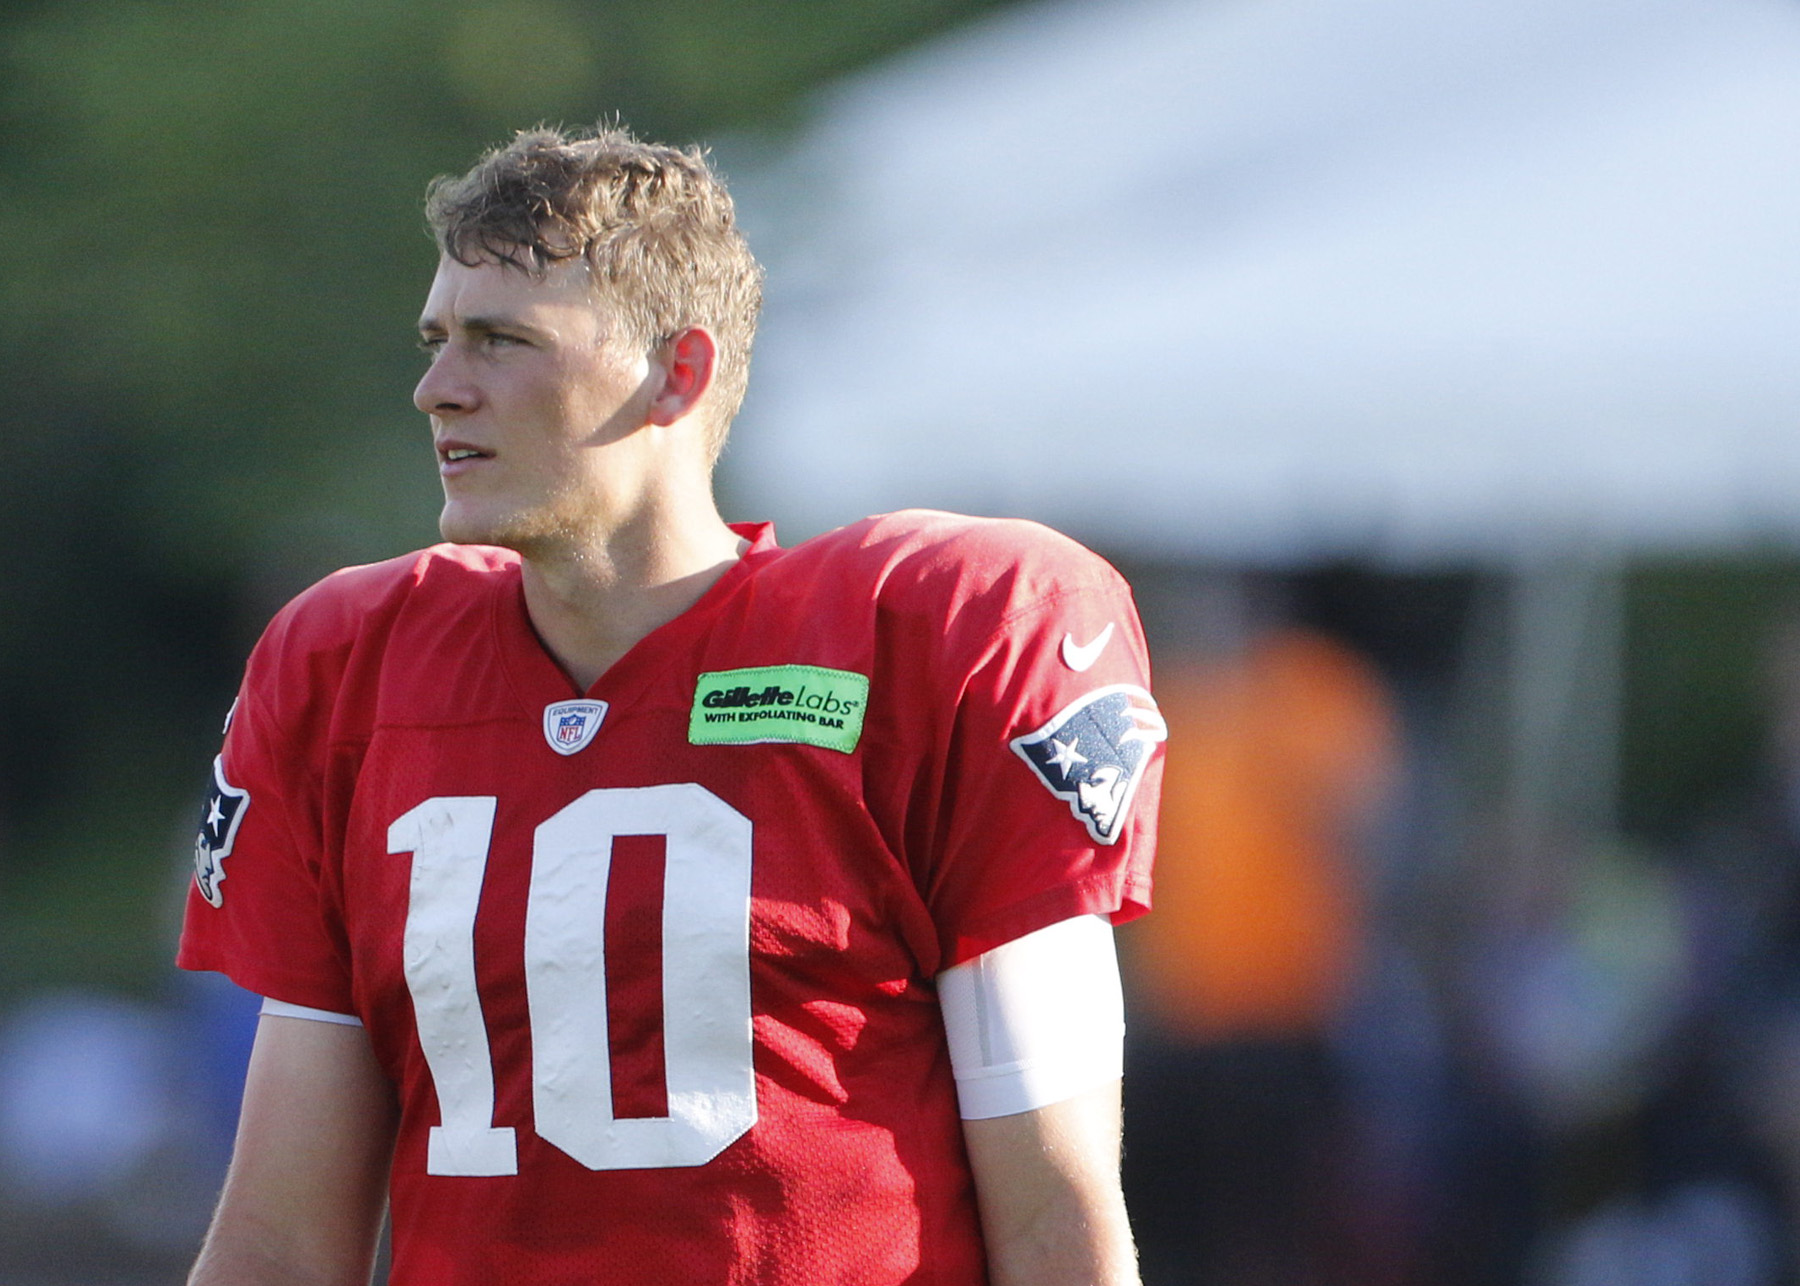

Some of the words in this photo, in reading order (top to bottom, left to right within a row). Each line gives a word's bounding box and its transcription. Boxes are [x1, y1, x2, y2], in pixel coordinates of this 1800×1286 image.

[552, 706, 599, 717] EQUIPMENT
[704, 711, 736, 723] WITH
[739, 710, 817, 723] EXFOLIATING
[819, 717, 845, 729] BAR
[559, 726, 581, 742] NFL
[387, 782, 759, 1177] 10
